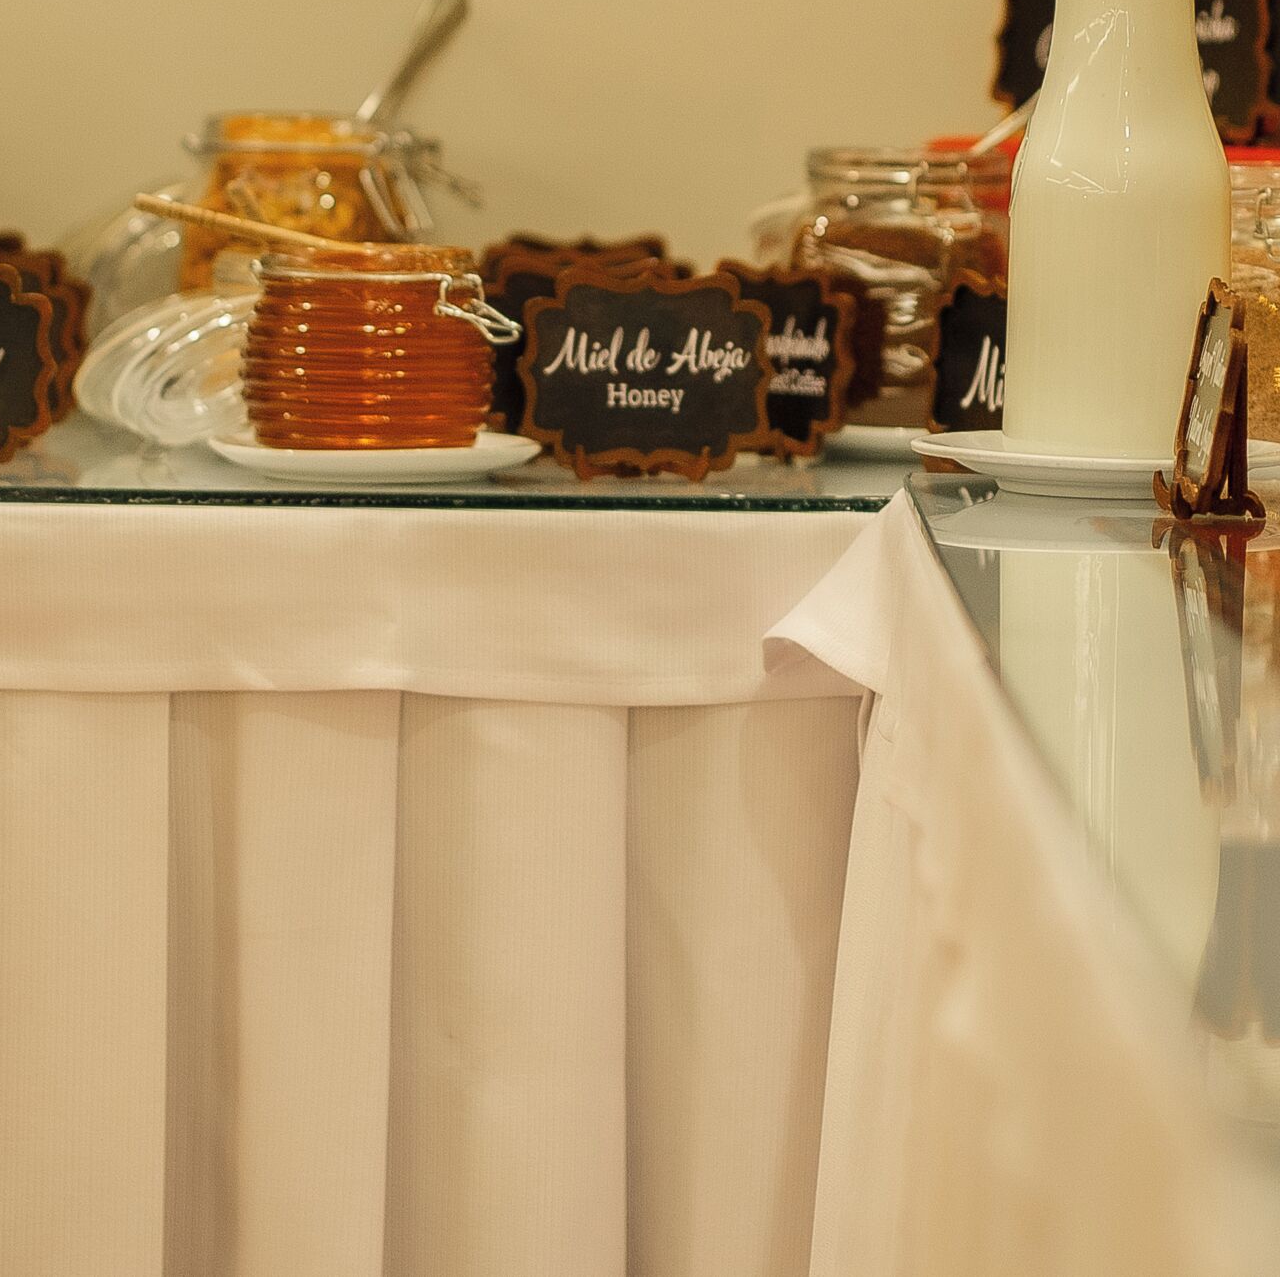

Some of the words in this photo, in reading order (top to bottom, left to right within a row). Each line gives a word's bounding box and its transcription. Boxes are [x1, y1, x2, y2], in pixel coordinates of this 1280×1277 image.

[542, 326, 624, 375] Miel
[625, 326, 662, 373] de
[665, 326, 752, 384] Abeja
[606, 382, 685, 415] Honey
